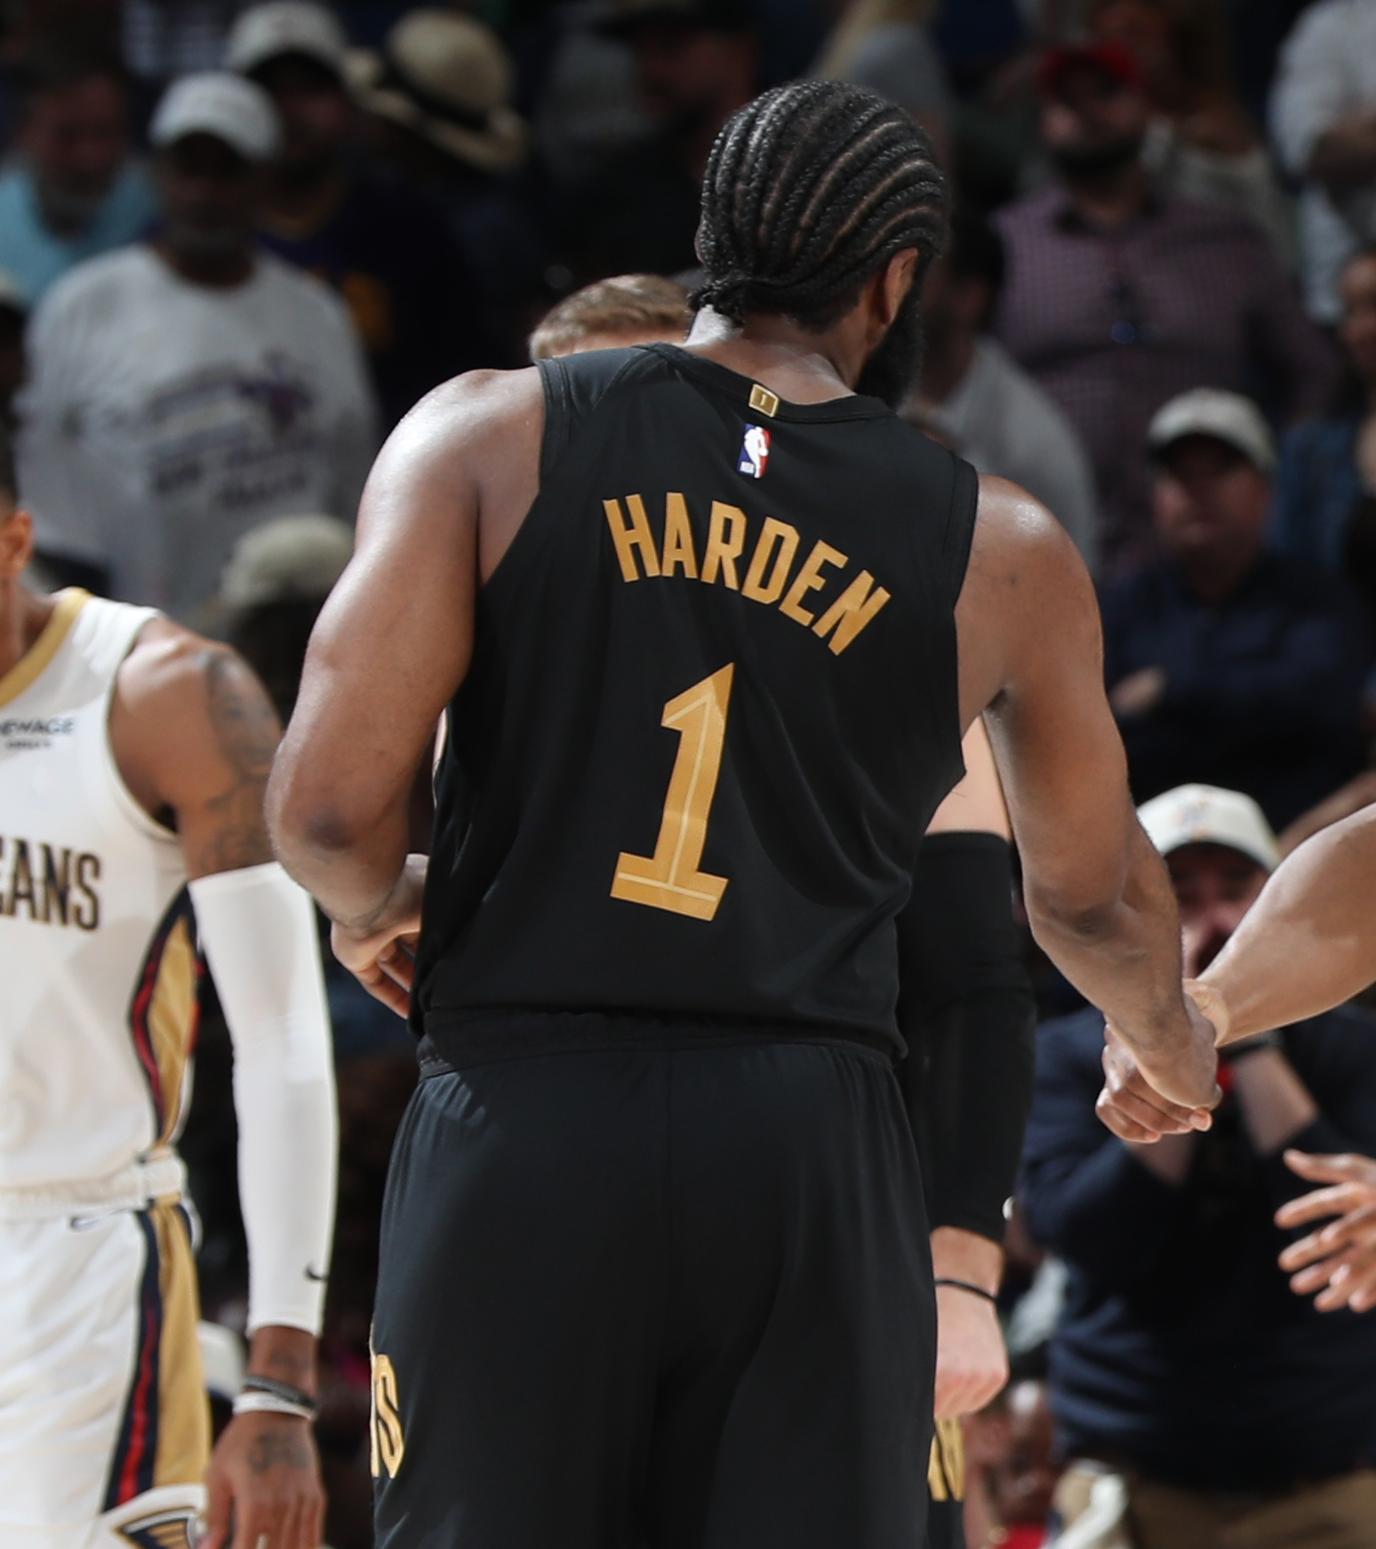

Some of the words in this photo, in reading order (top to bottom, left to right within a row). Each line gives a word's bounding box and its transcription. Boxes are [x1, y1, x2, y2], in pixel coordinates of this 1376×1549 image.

[602, 491, 892, 657] HARDEN
[609, 661, 735, 922] 1
[0, 836, 102, 932] ANS
